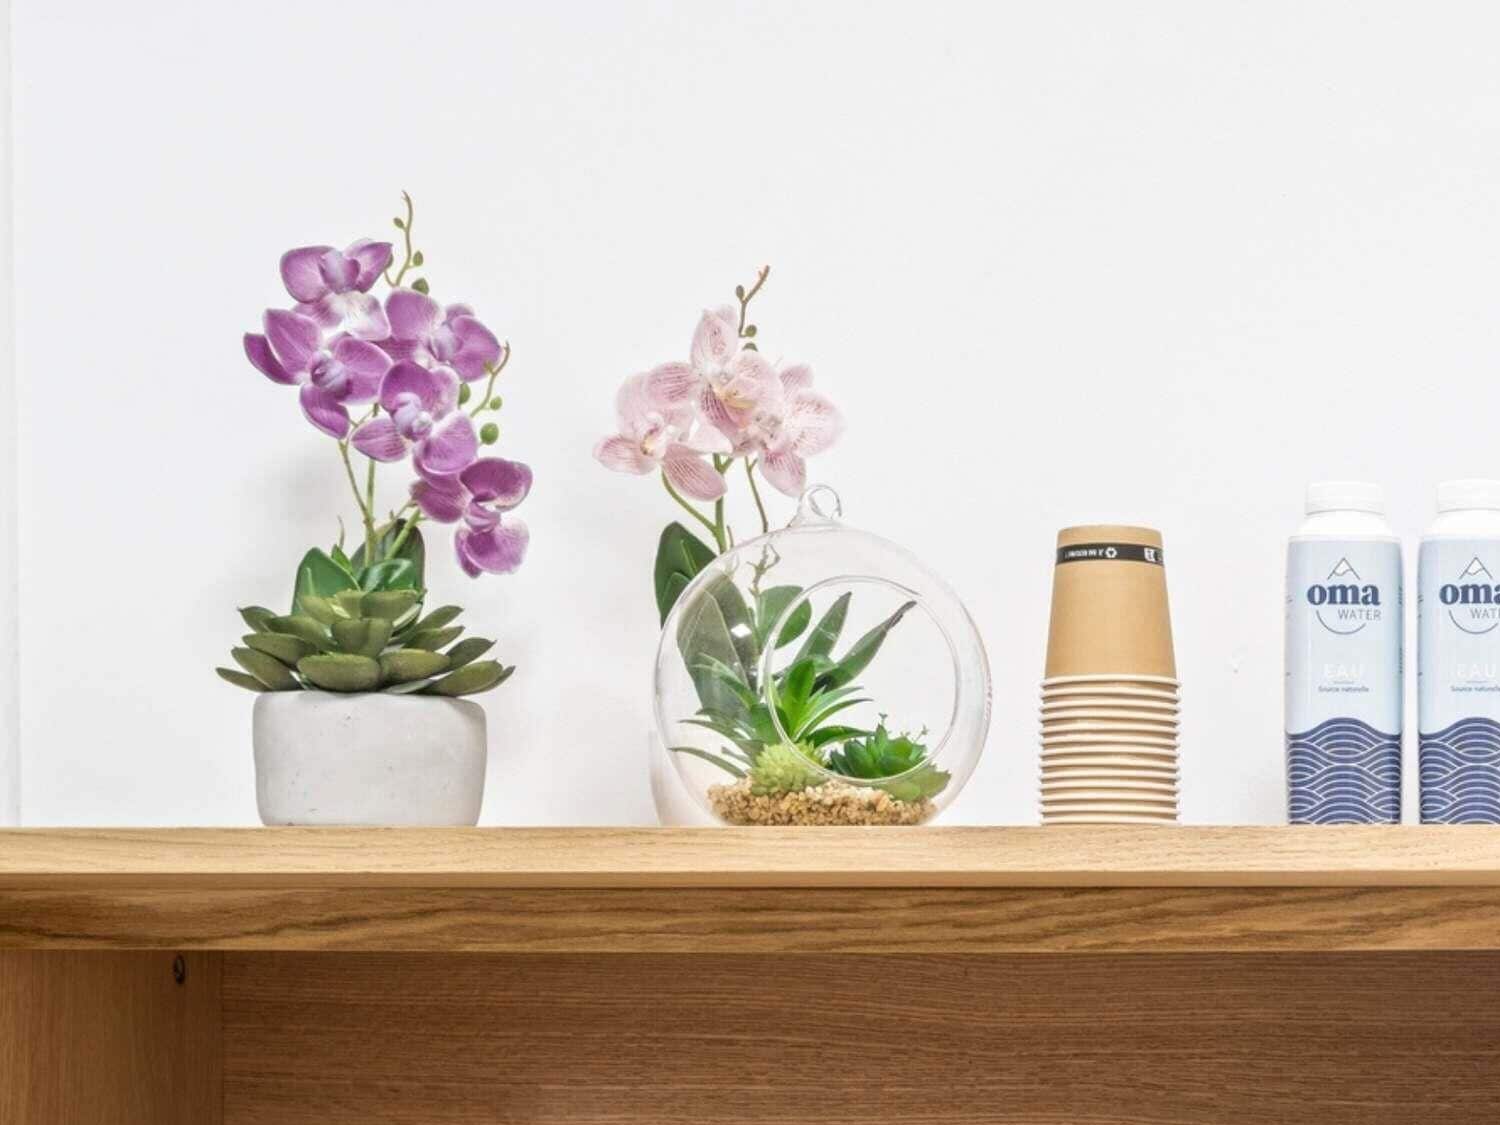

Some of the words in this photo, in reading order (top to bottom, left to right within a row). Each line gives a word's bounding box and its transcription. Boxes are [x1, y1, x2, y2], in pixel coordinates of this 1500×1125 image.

[1307, 584, 1381, 605] oma
[1338, 609, 1381, 621] WATER
[1457, 663, 1496, 679] EAU
